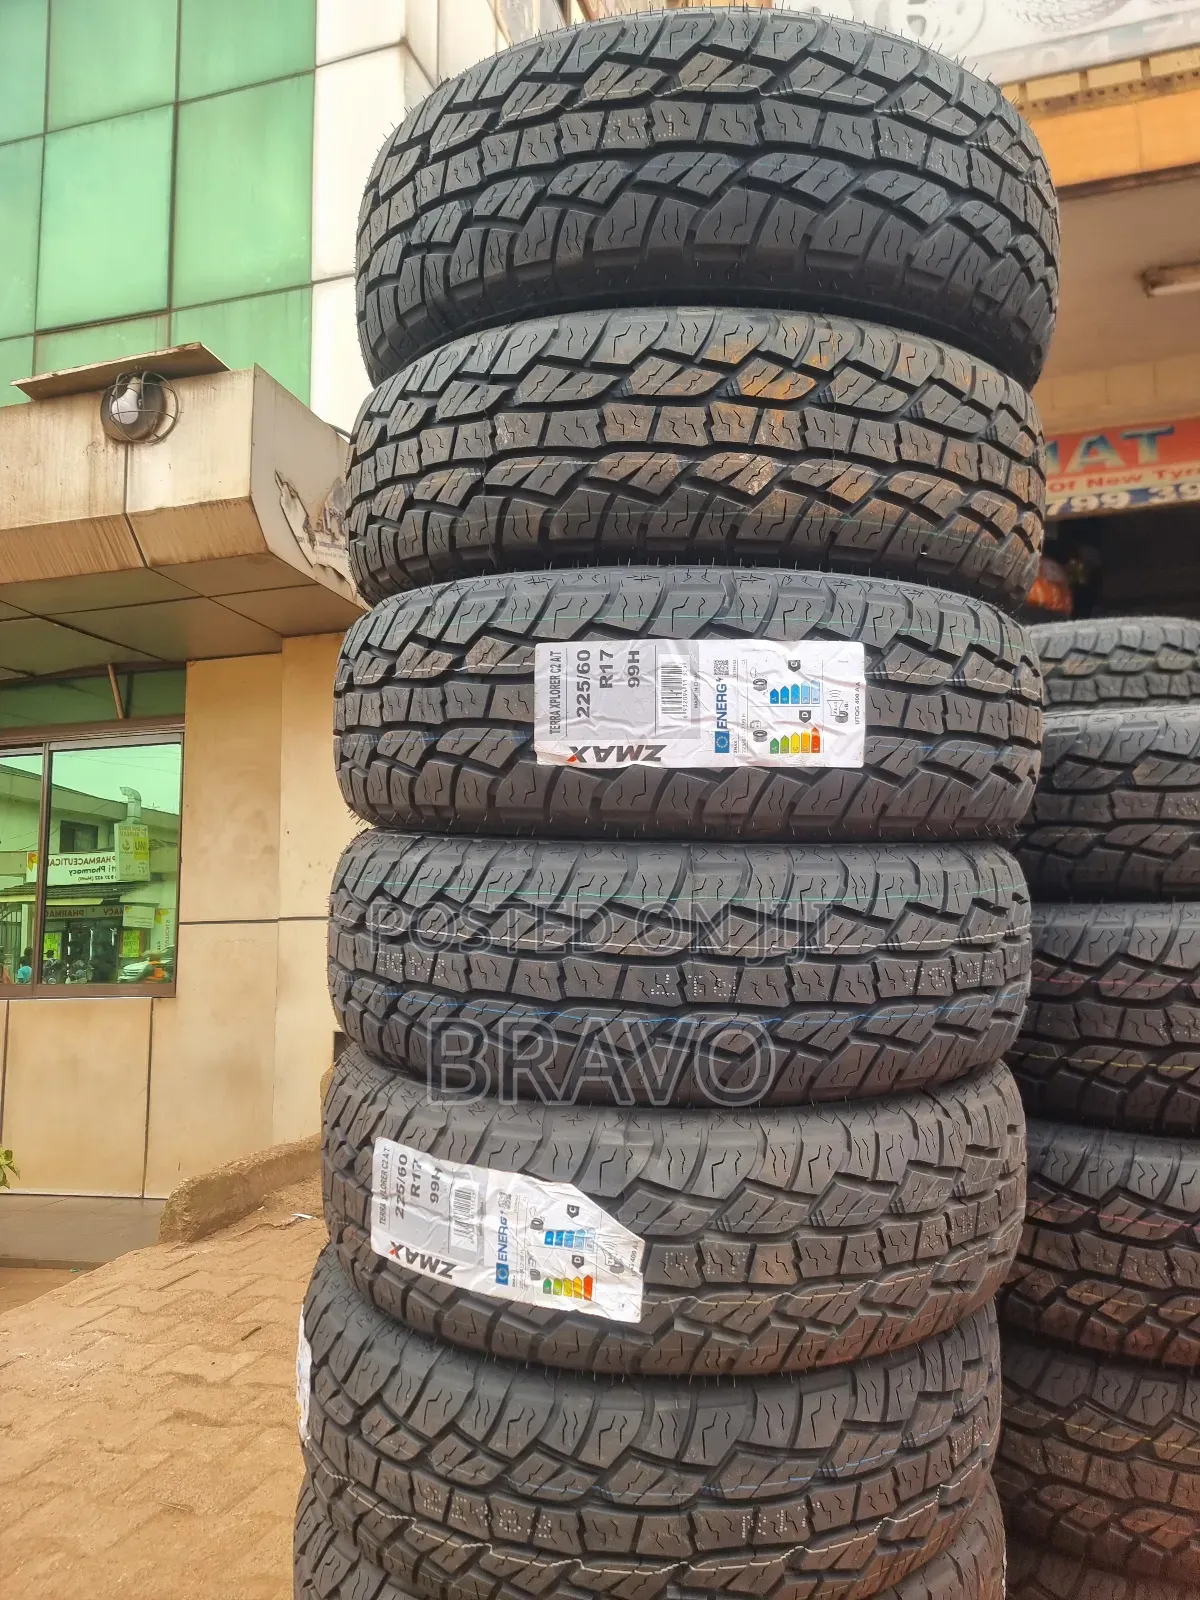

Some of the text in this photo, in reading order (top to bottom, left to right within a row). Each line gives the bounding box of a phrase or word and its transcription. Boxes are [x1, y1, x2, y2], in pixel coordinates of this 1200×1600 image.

[1087, 475, 1142, 489] New
[550, 663, 562, 676] C2
[576, 649, 591, 718] 225/60
[599, 649, 614, 689] R17
[627, 650, 640, 688] 99H
[549, 675, 562, 709] XPLORER
[716, 683, 728, 730] ENERG
[549, 709, 562, 735] TERRA
[566, 744, 668, 763] ZMAX
[395, 1153, 408, 1220] 225/60
[410, 1158, 422, 1198] R17
[429, 1167, 443, 1204] 99H
[379, 1199, 388, 1226] TERRA
[497, 1217, 509, 1263] ENERG
[388, 1241, 457, 1280] ZMAX
